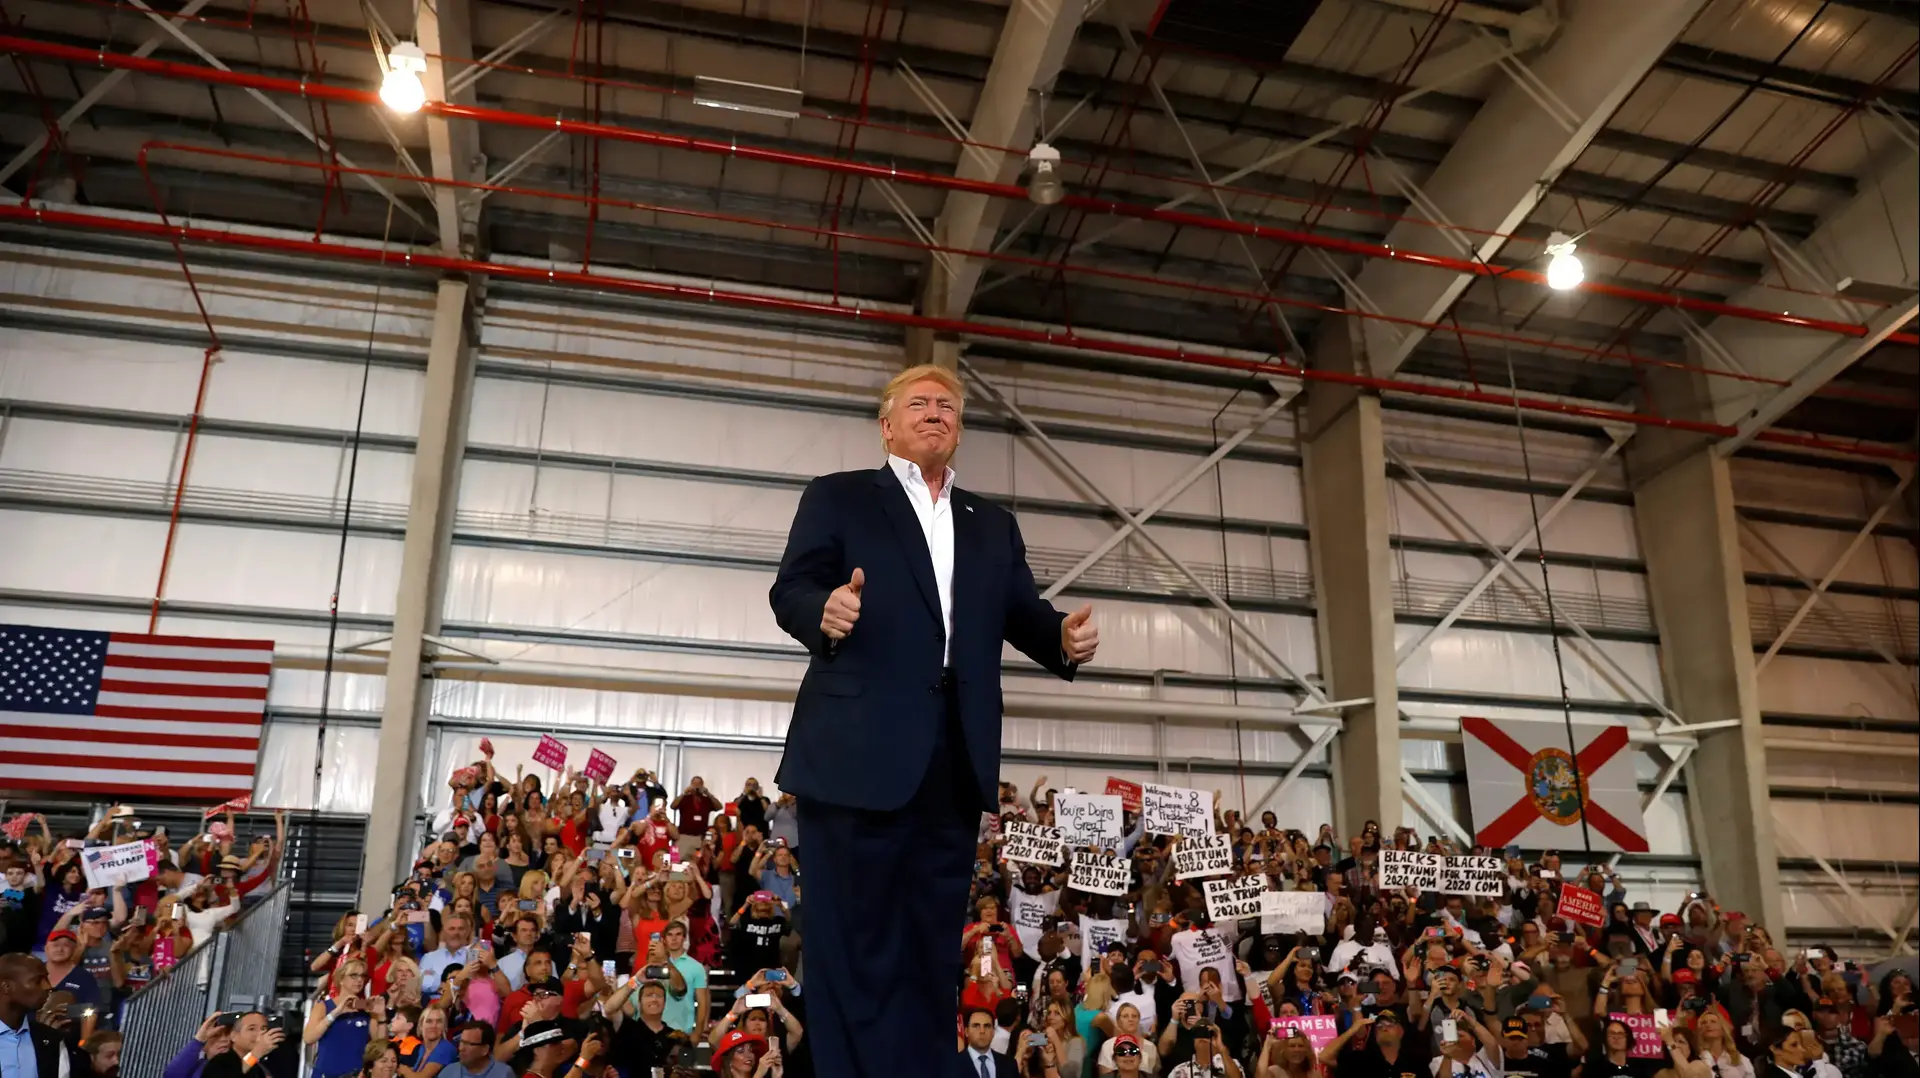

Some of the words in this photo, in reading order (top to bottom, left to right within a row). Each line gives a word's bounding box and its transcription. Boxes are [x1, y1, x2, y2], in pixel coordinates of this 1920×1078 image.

[1144, 785, 1172, 798] Welcome
[1174, 790, 1183, 799] to
[1189, 791, 1200, 808] 8
[1145, 796, 1158, 811] Big
[1088, 802, 1115, 821] Doing
[1010, 821, 1061, 840] BLACKS
[1072, 815, 1106, 831] Great
[1145, 818, 1174, 833] Donald
[1174, 818, 1209, 838] Trump!
[1009, 834, 1024, 845] FOR
[1026, 837, 1060, 851] TRUMP
[1176, 835, 1224, 853] BLACKS
[1006, 844, 1032, 858] 2020
[1177, 852, 1193, 863] FOR
[1195, 848, 1228, 861] TRUMP
[1384, 851, 1437, 866] BLACKS
[100, 854, 144, 869] TRUMP
[1077, 853, 1126, 870] BLACKS
[1179, 861, 1204, 875] 2020
[1445, 856, 1498, 869] BLACKS
[1074, 865, 1092, 877] FOR
[1094, 867, 1128, 881] TRUMP
[1384, 864, 1399, 875] FOR
[1402, 865, 1437, 877] TRUMP
[1463, 870, 1500, 881] TRUMP
[1072, 874, 1100, 888] 2020
[1209, 874, 1260, 893] BLACKS
[1384, 874, 1409, 887] 2020
[1413, 876, 1437, 888] COM
[1445, 879, 1471, 891] 2020
[1475, 881, 1499, 893] COM
[1211, 893, 1231, 904] FOR
[1233, 885, 1268, 901] TRUMP
[1562, 895, 1600, 913] AMERIC
[1271, 1018, 1336, 1030] WOMEN
[1632, 1031, 1656, 1040] FOR
